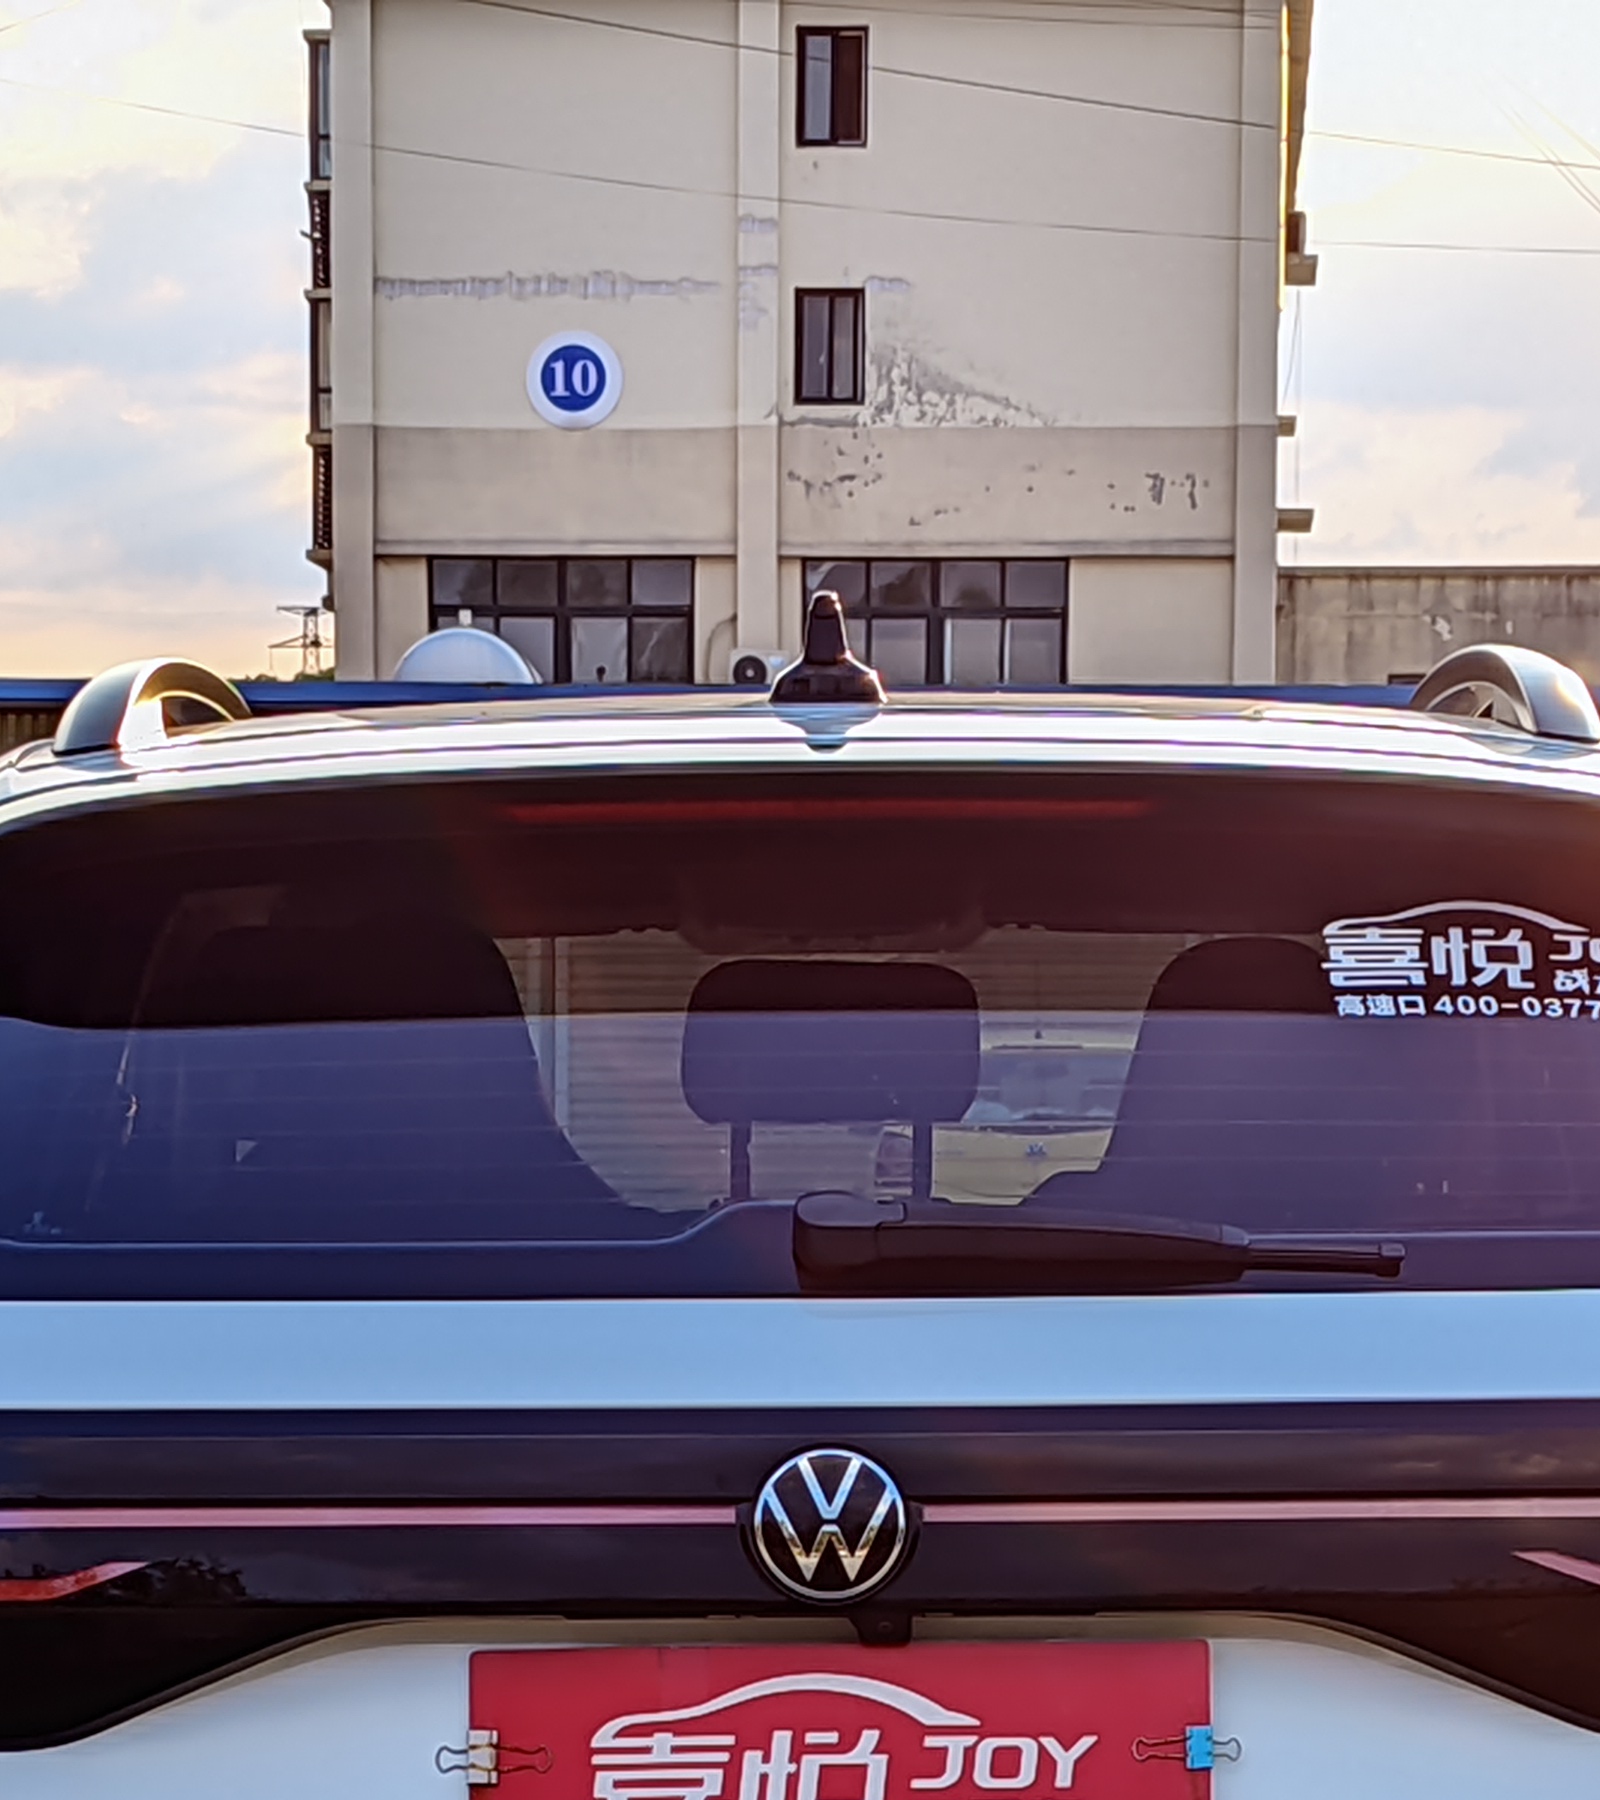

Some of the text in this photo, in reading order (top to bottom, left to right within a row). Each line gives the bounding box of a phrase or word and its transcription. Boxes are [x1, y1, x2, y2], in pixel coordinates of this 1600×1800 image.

[549, 358, 598, 397] 10
[1321, 927, 1536, 989] 喜悦
[1335, 994, 1427, 1017] 高速口
[910, 1735, 1098, 1789] JOY
